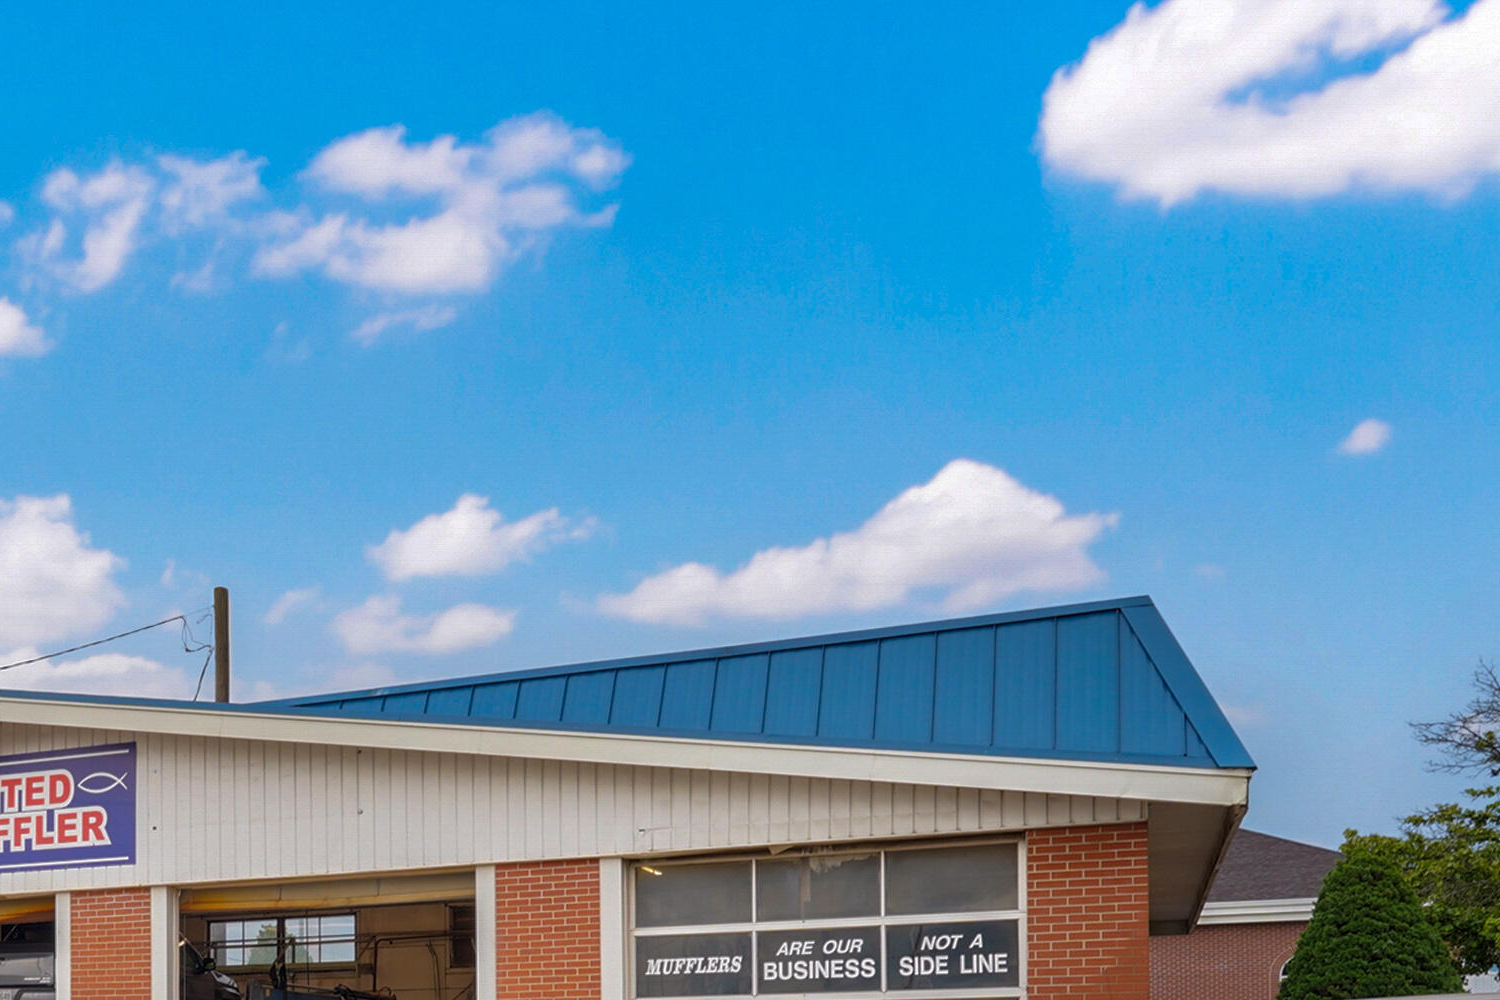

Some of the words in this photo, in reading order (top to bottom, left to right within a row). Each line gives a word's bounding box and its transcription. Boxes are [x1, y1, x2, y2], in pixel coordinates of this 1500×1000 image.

[776, 940, 815, 956] ARE
[823, 938, 864, 955] OUR
[921, 934, 963, 951] NOT
[969, 933, 983, 949] A
[645, 955, 743, 976] MUFFLERS
[763, 957, 876, 981] BUSINESS
[899, 955, 949, 977] SIDE
[960, 953, 1008, 974] LINE
